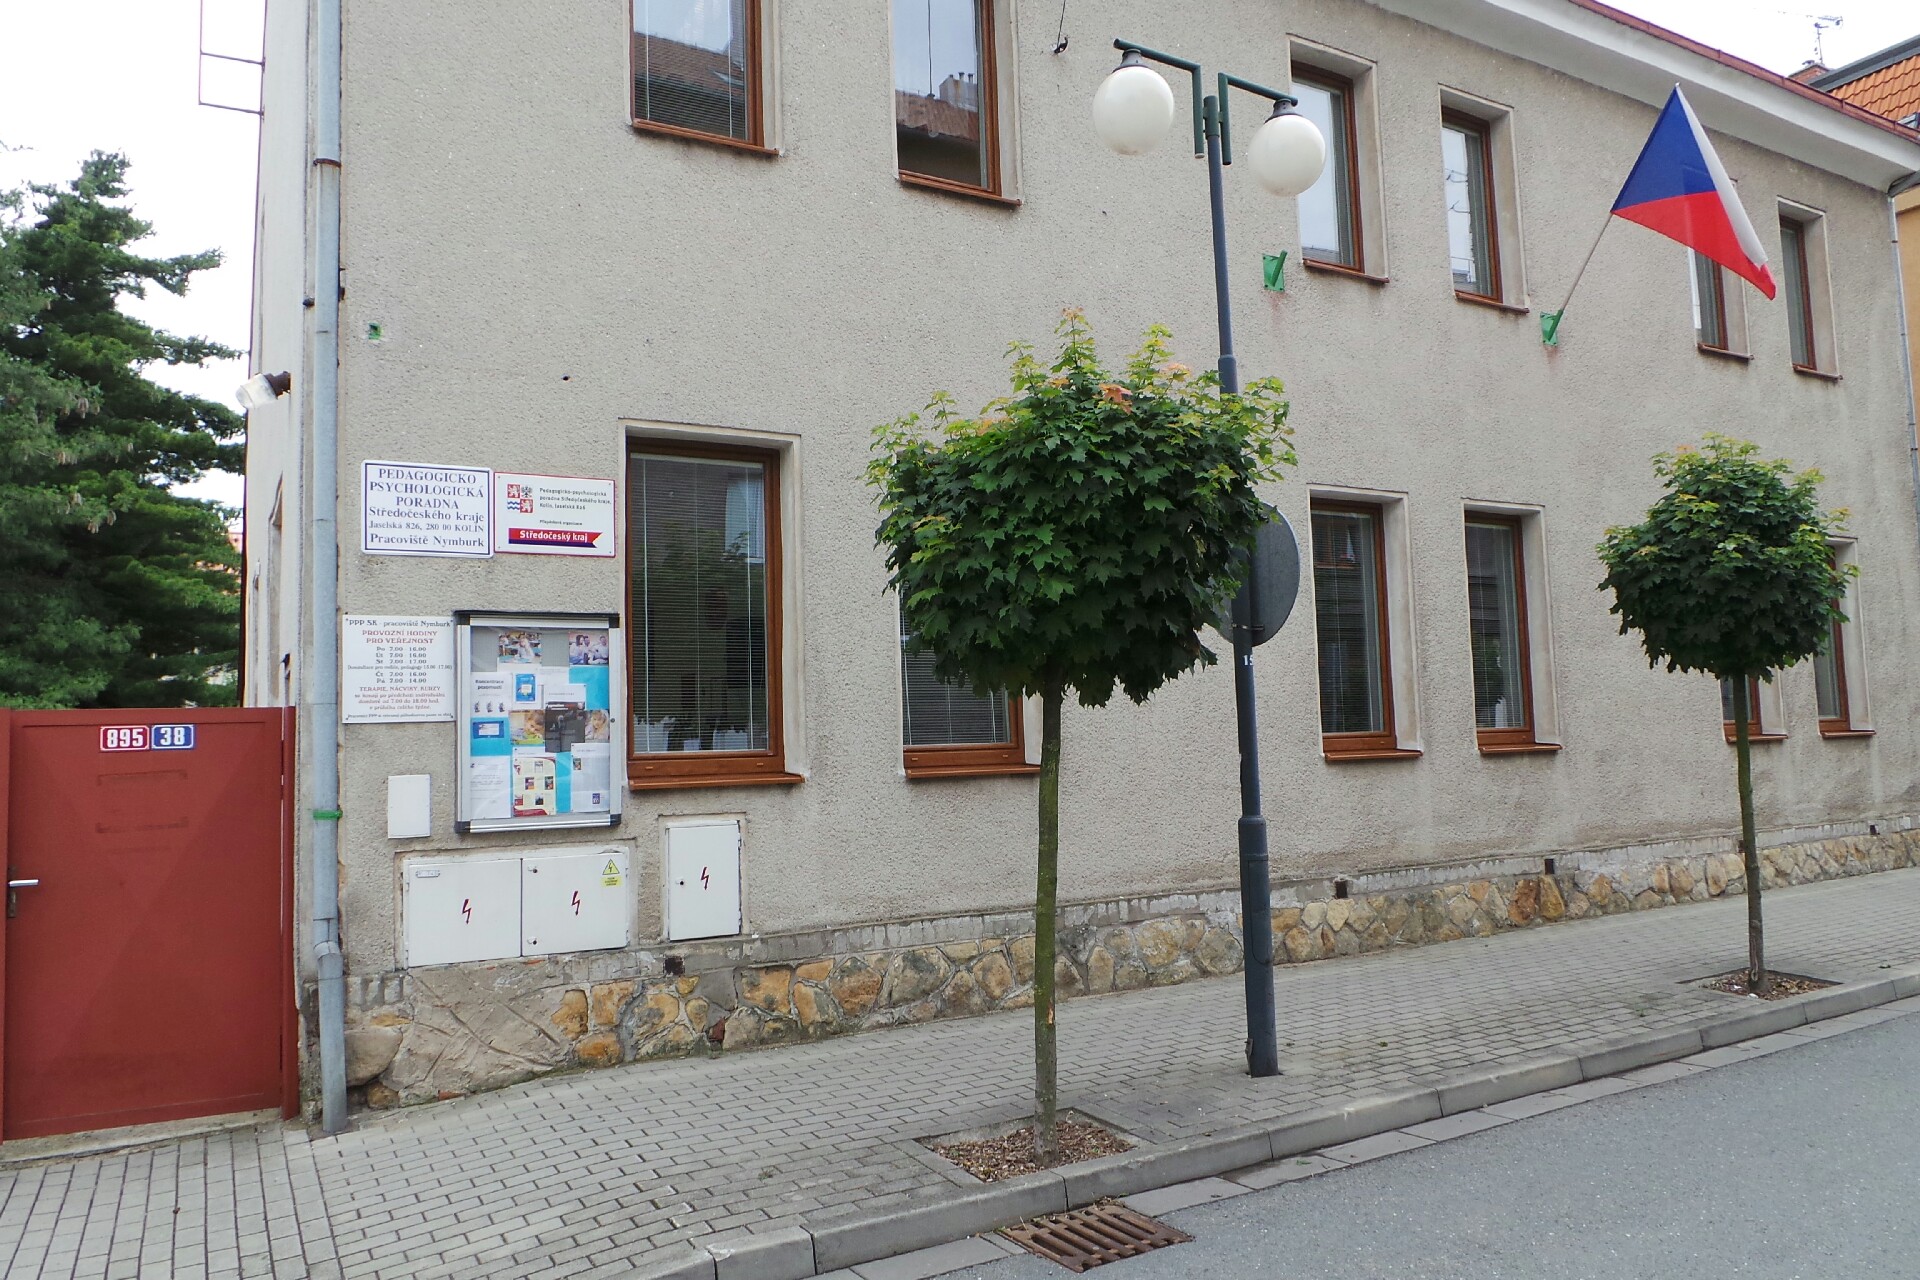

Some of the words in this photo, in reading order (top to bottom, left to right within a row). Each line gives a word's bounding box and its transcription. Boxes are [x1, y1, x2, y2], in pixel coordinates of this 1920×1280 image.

[378, 468, 476, 484] PEDAGOGICKO
[370, 481, 484, 498] PSYCHOLOGICKÁ
[396, 496, 459, 510] PORADNA
[370, 506, 451, 520] Středočeského
[456, 511, 484, 524] kraje
[368, 520, 402, 529] Jaselská
[406, 522, 422, 531] 826,
[454, 523, 484, 532] KOLÍN
[370, 533, 428, 545] Pracoviště
[433, 536, 484, 548] Nymburk
[520, 530, 571, 542] Středočeský
[573, 532, 588, 544] kraj
[421, 620, 451, 628] Nymburk
[107, 728, 144, 748] 895
[160, 727, 186, 746] 38
